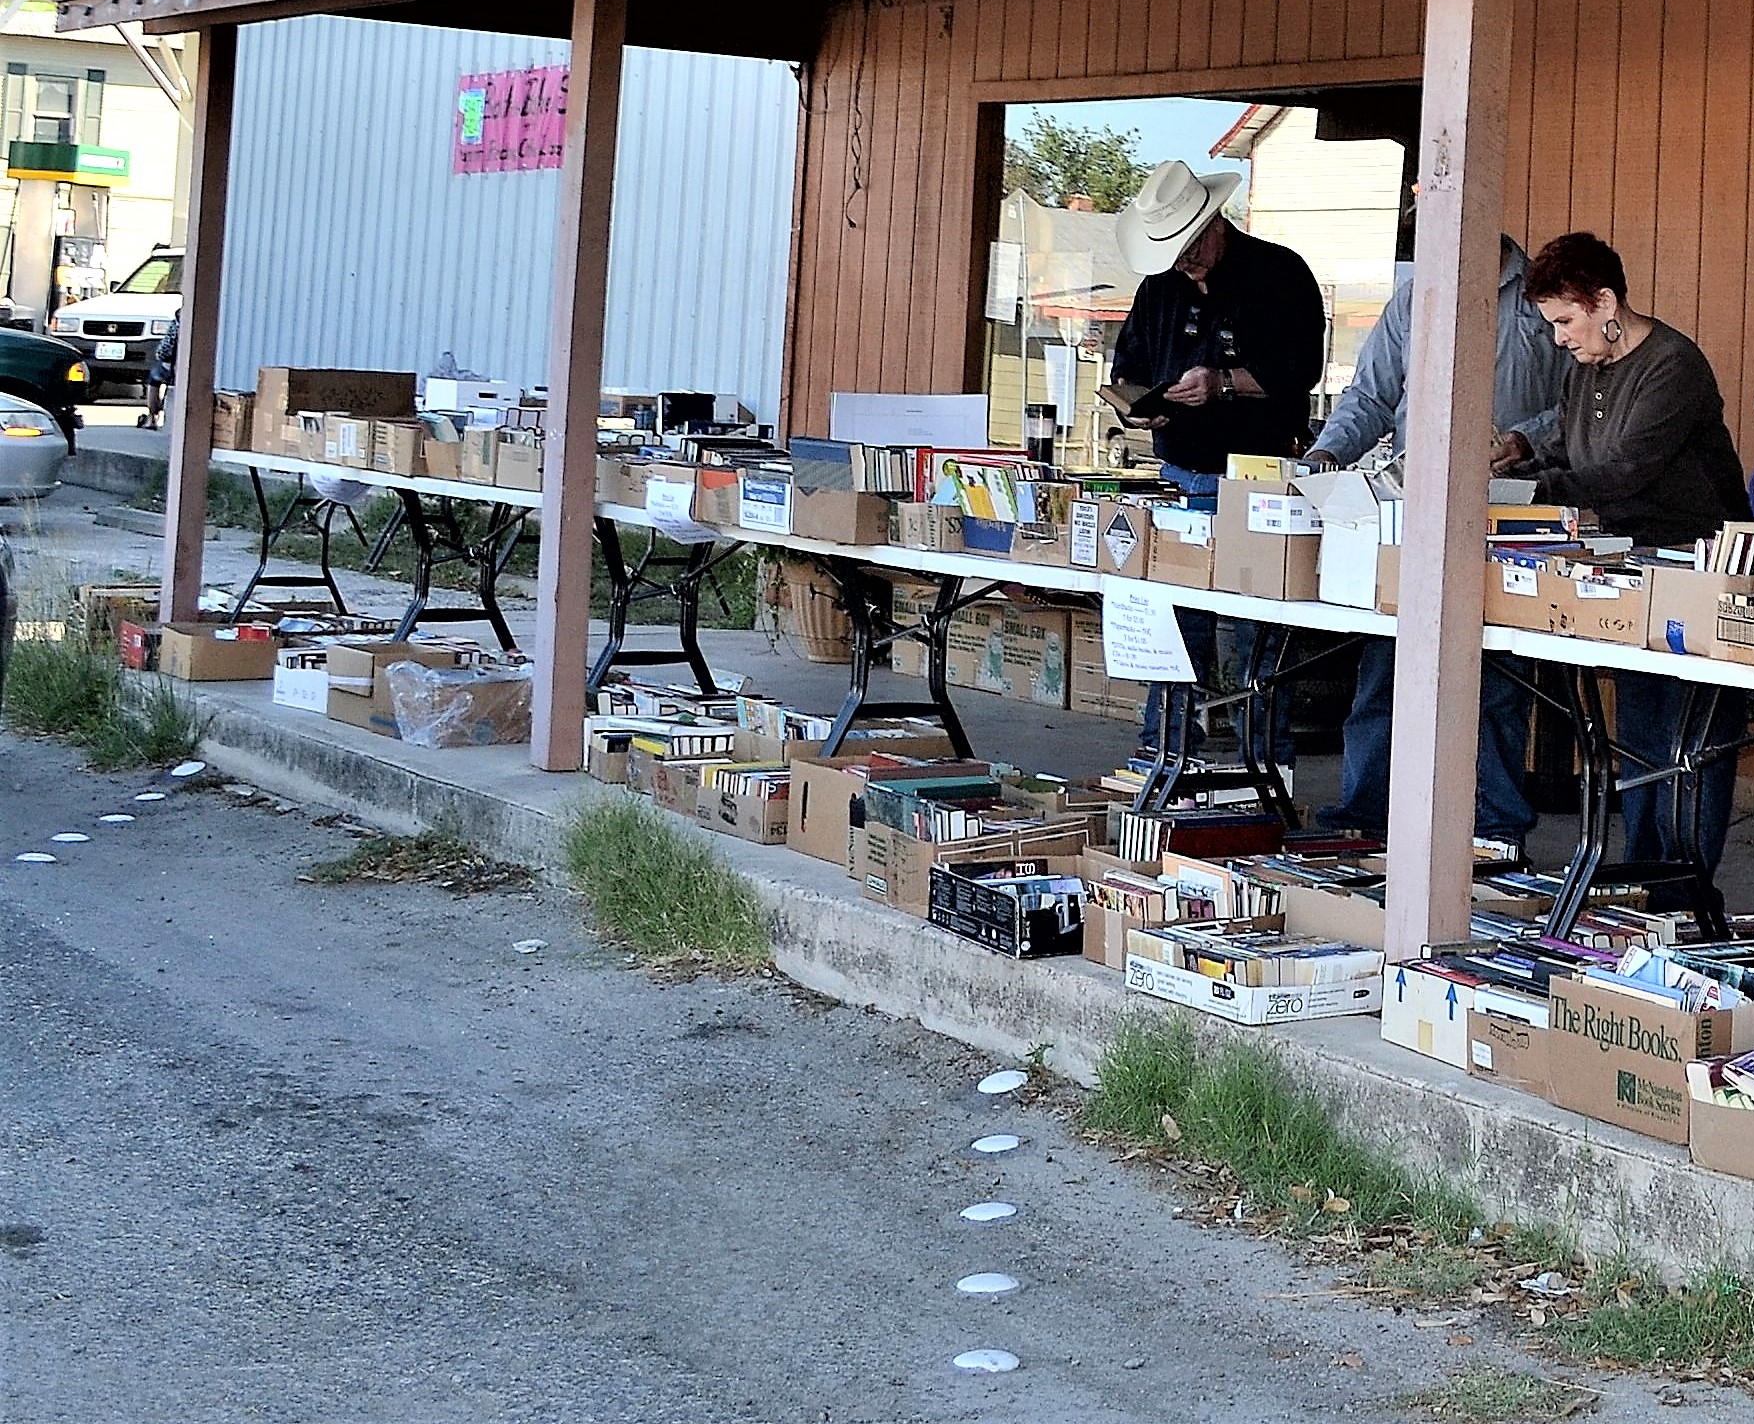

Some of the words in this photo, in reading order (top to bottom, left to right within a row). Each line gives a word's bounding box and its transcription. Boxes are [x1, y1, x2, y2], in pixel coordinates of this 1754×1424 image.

[951, 608, 973, 623] MALL
[1129, 967, 1154, 991] zero
[1267, 997, 1303, 1015] zero
[1552, 995, 1580, 1034] The
[1583, 1003, 1624, 1052] Right
[1627, 1016, 1682, 1063] Books.
